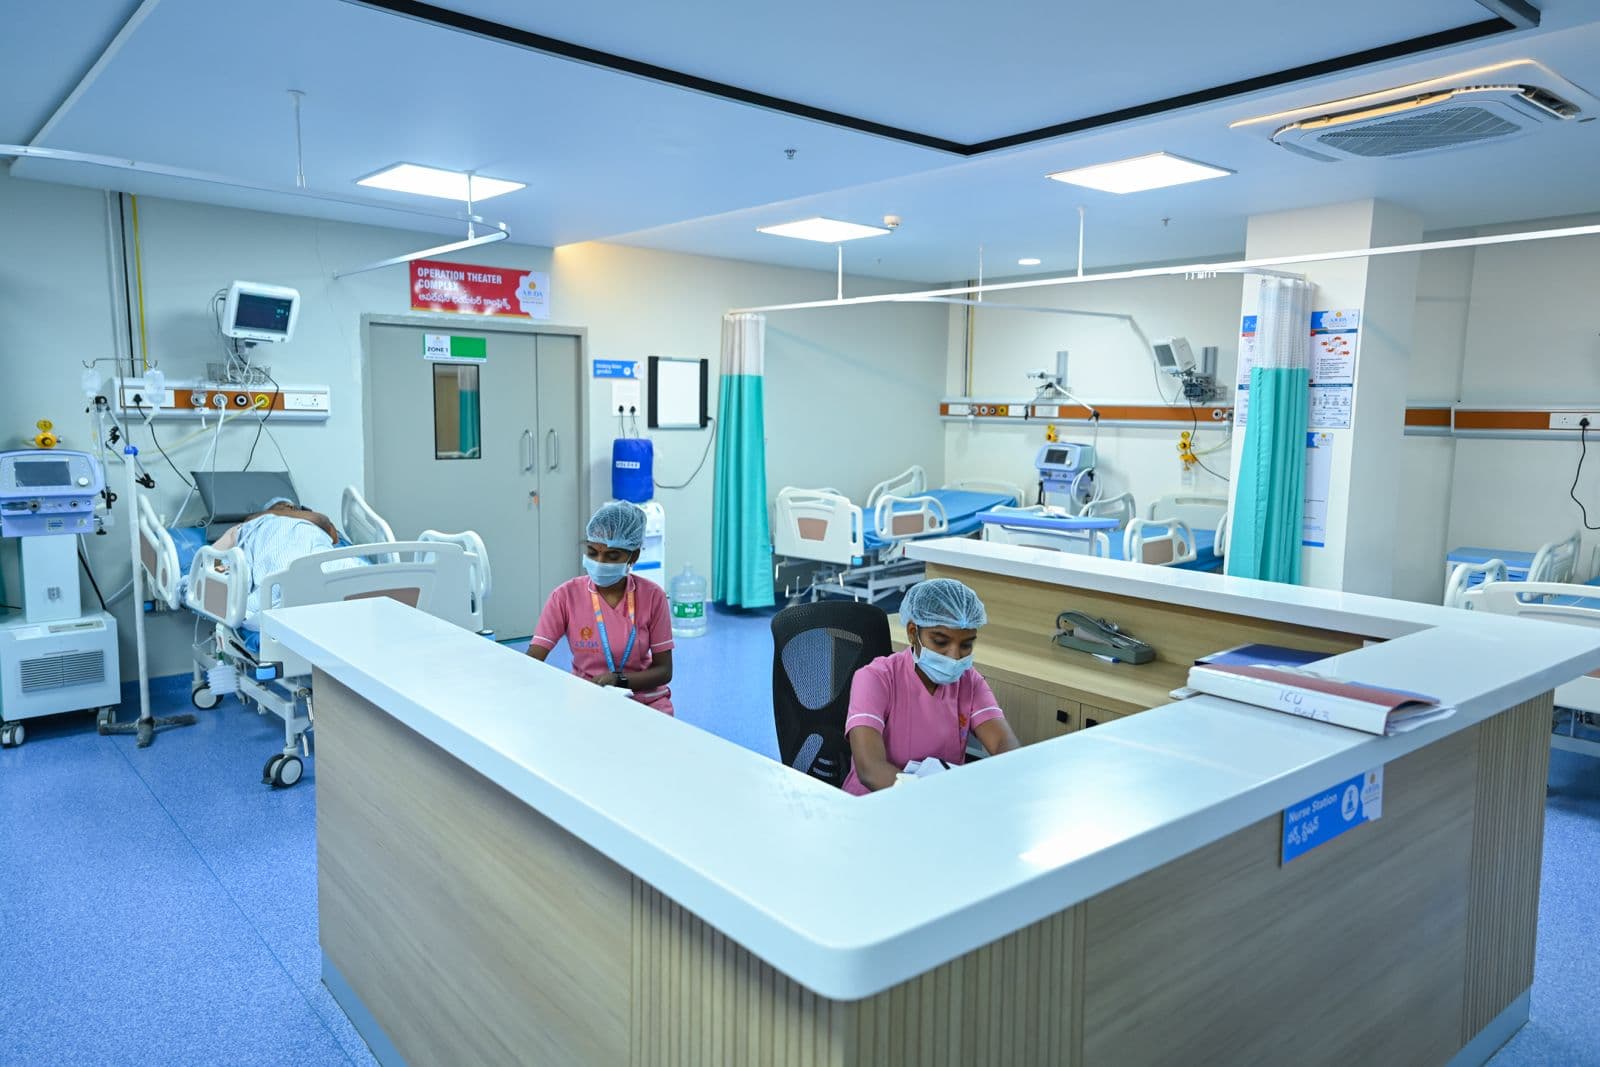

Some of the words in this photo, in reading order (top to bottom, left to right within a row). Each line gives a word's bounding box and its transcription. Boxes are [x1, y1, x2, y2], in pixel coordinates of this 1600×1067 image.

[417, 267, 465, 281] OPERATION
[467, 272, 502, 284] THEATER
[417, 279, 459, 292] COMPLEX
[1279, 690, 1304, 705] ICU
[1288, 806, 1311, 823] Nurse
[1311, 793, 1338, 813] Station
